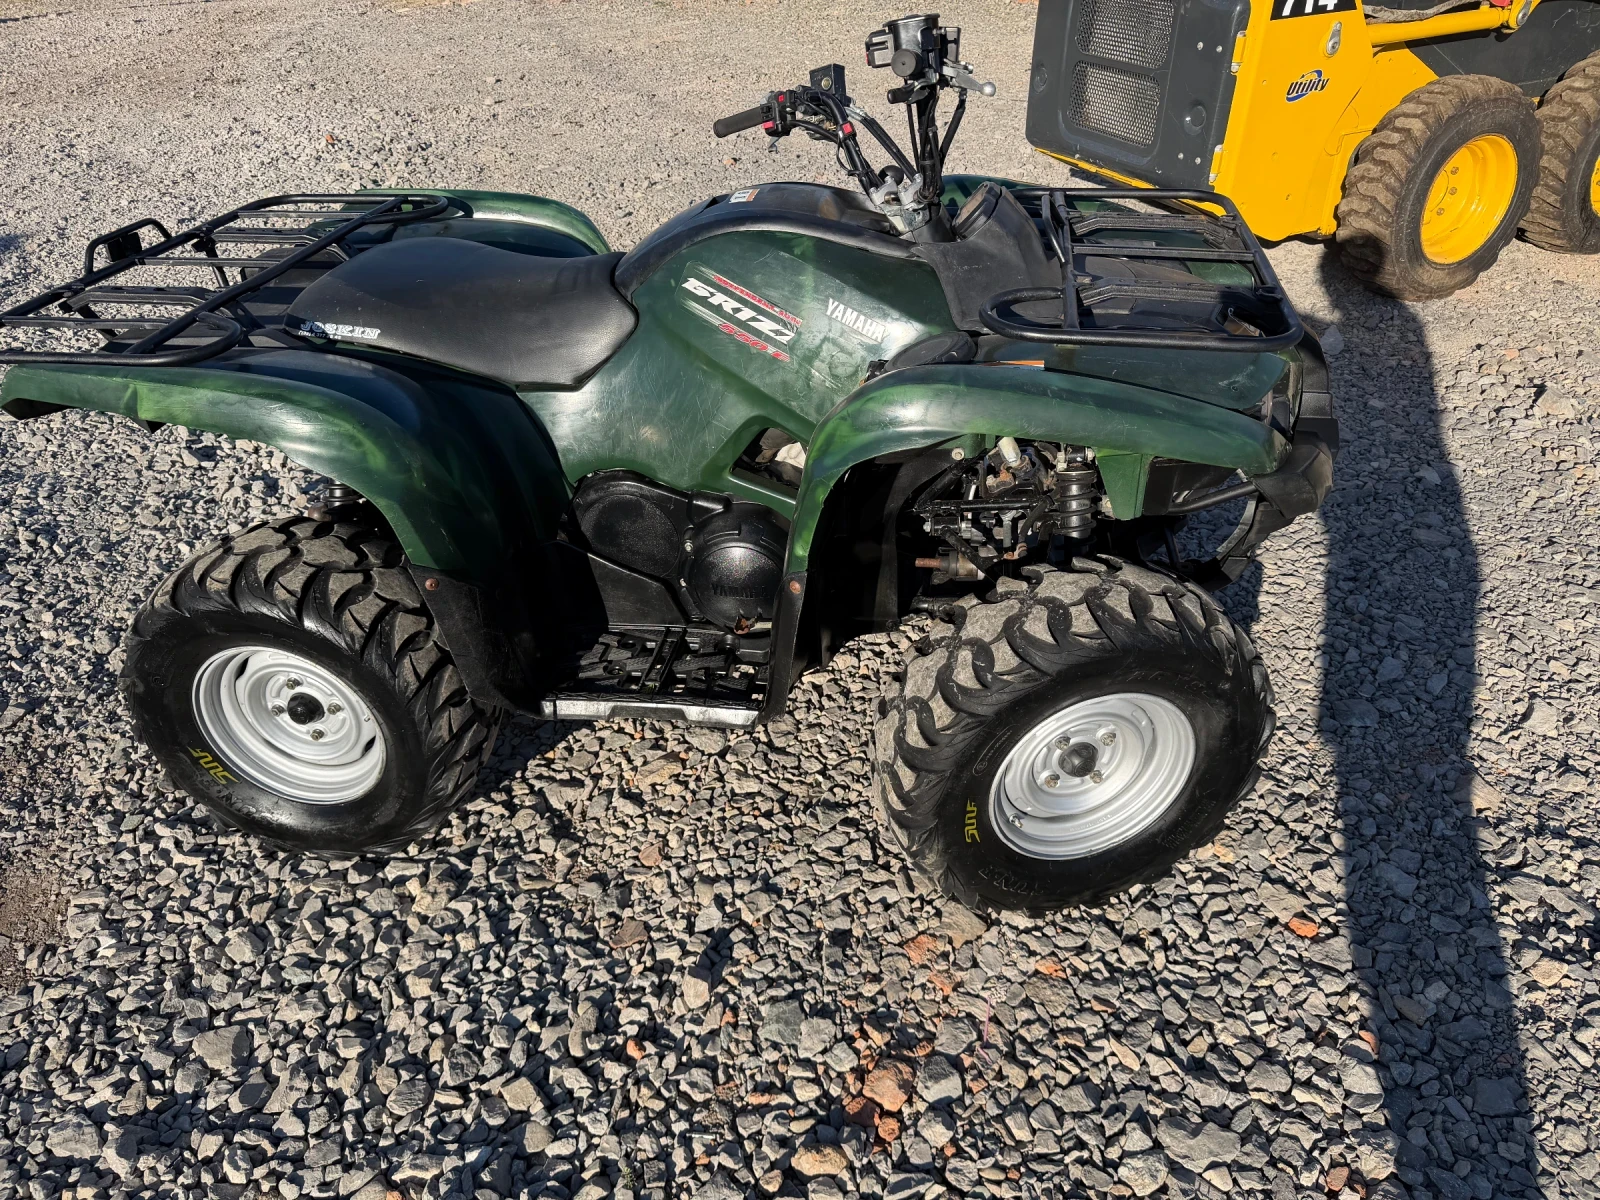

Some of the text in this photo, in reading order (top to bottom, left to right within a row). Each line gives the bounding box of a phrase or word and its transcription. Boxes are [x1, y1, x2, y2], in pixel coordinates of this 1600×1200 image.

[1286, 78, 1330, 96] Utility
[300, 320, 381, 339] JOSKIN
[825, 298, 886, 344] YAMAHA
[718, 323, 769, 351] 550
